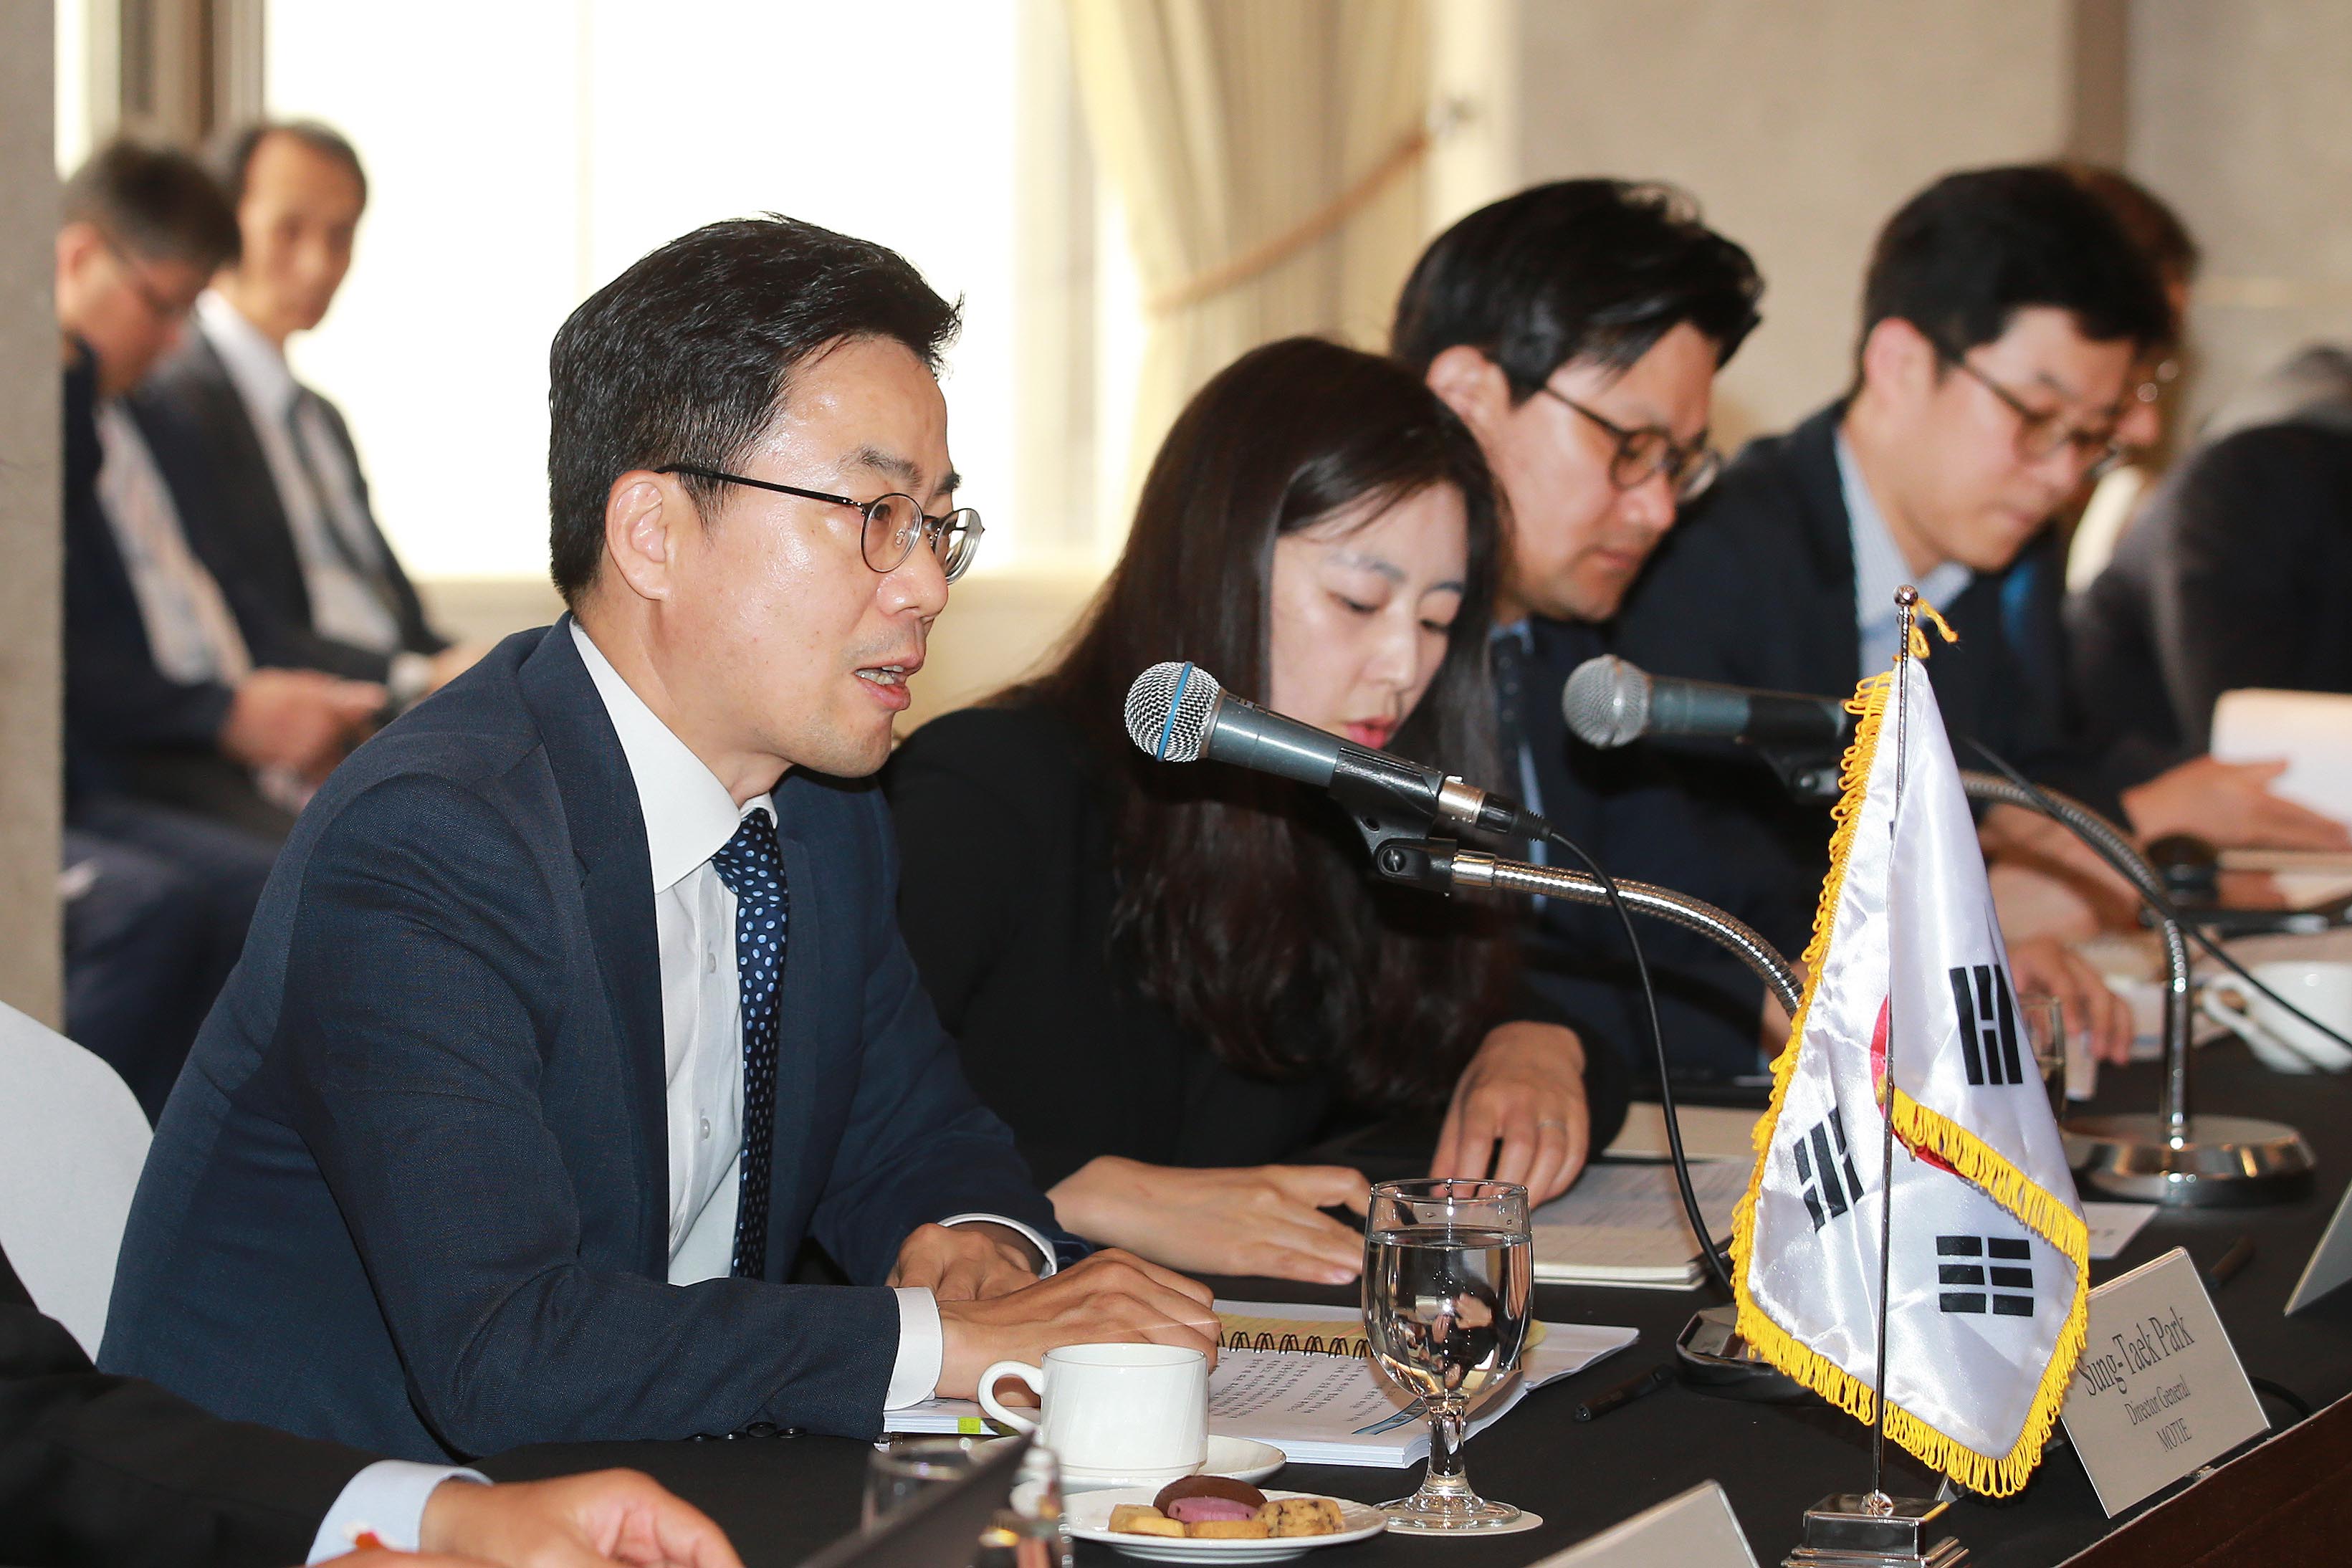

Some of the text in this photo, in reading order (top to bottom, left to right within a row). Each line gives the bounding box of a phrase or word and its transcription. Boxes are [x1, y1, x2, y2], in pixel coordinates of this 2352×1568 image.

[2075, 1306, 2196, 1397] Sung-Taek Park
[2124, 1374, 2191, 1425] Director General
[2156, 1418, 2192, 1453] MOTIE
